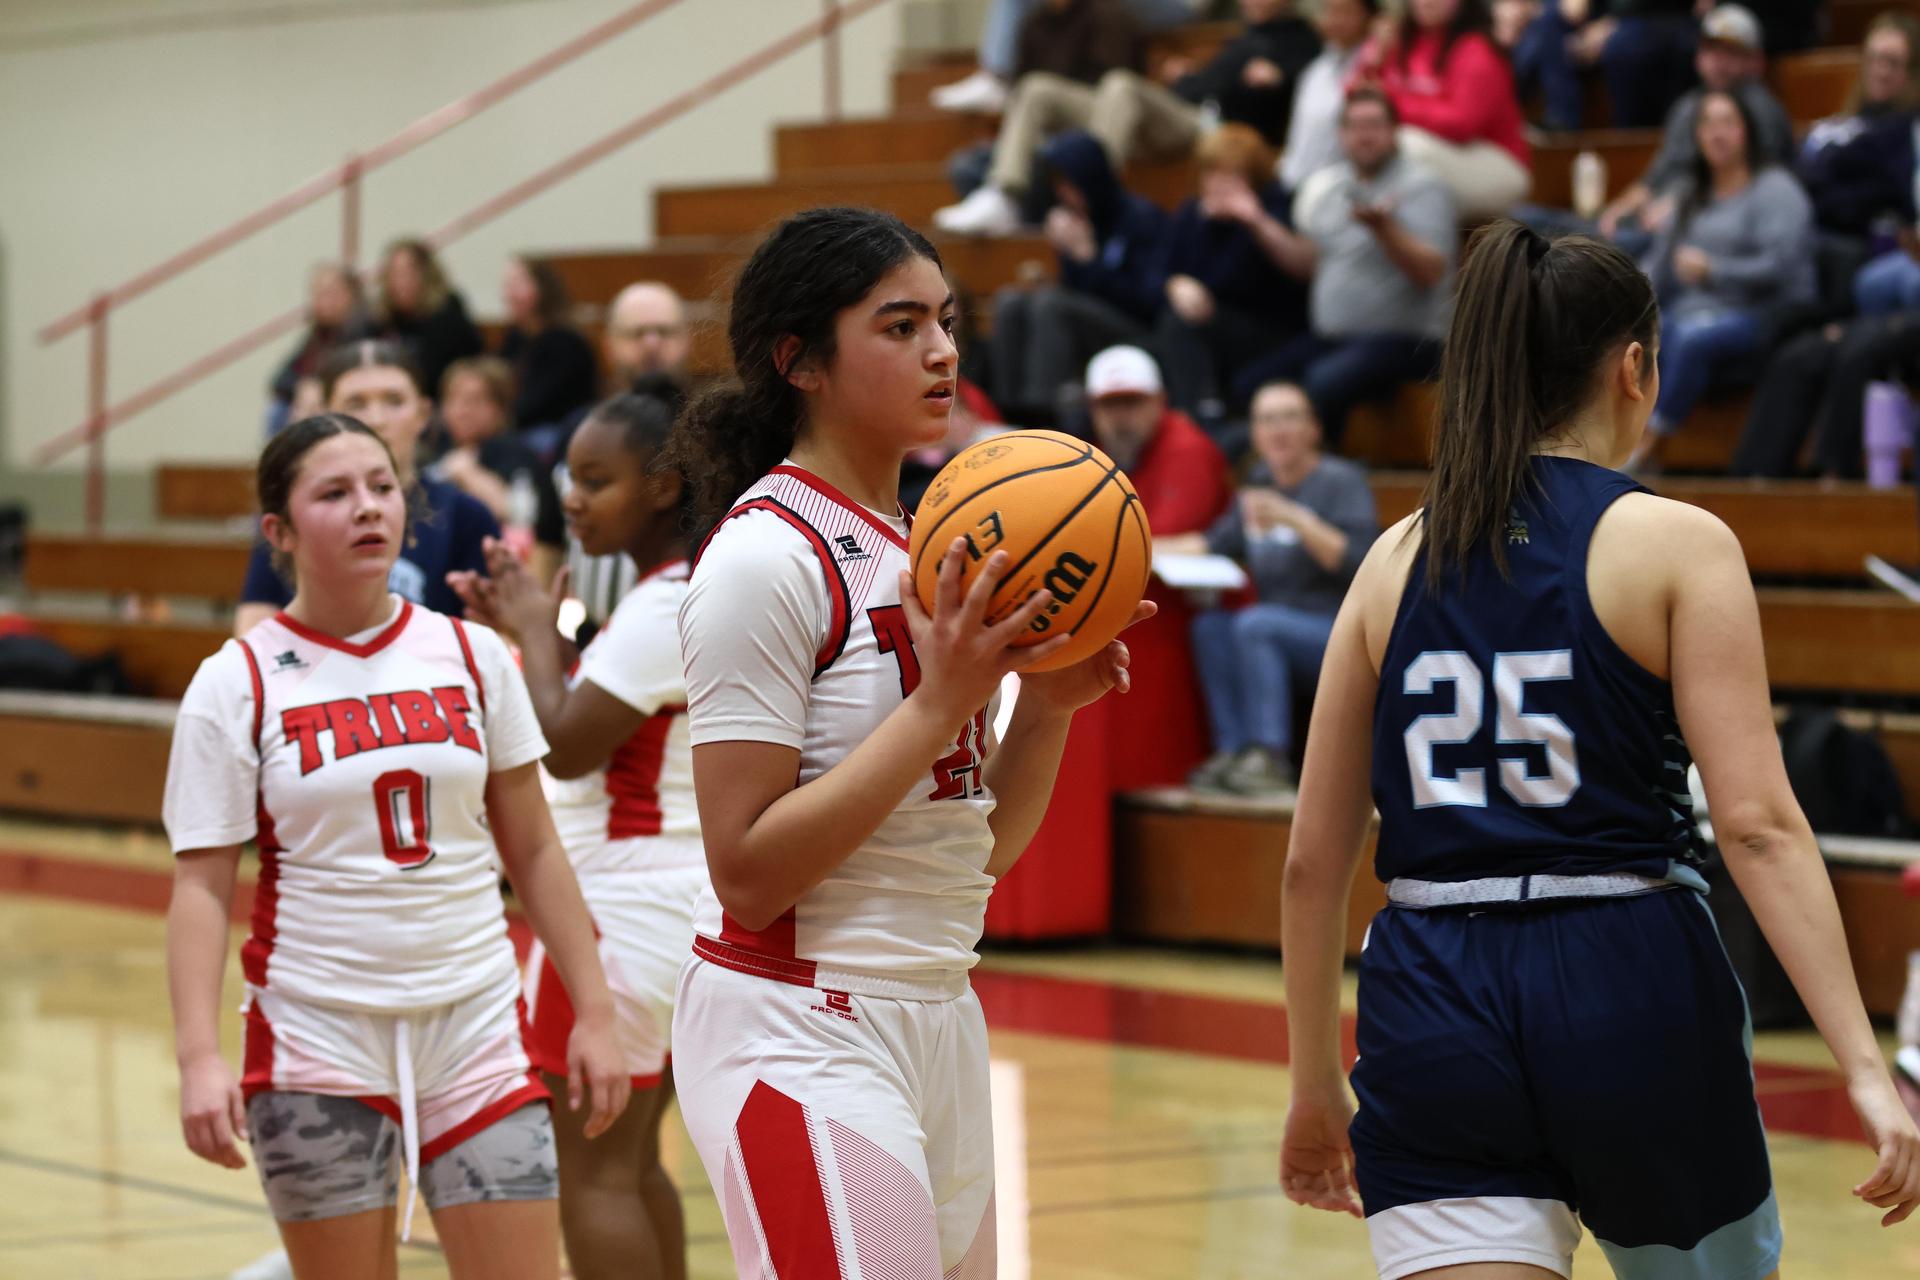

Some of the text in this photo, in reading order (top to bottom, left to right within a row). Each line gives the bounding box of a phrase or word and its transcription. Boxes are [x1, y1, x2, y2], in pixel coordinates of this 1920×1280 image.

[837, 553, 873, 564] PROLOOK
[281, 686, 483, 777] TRIBE
[1403, 649, 1582, 810] 25
[373, 768, 437, 871] 0
